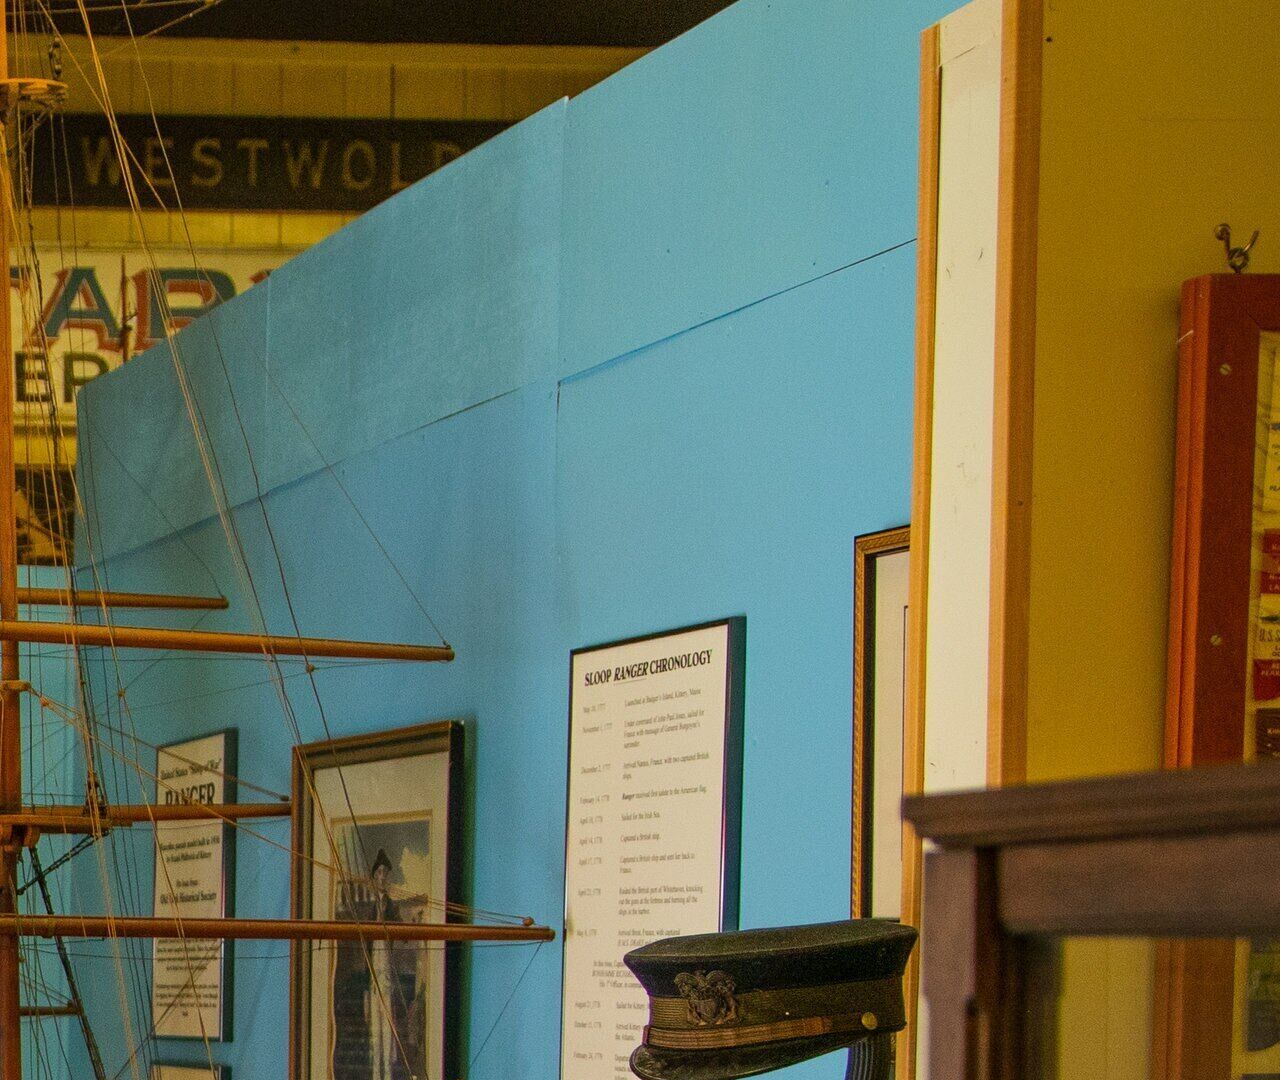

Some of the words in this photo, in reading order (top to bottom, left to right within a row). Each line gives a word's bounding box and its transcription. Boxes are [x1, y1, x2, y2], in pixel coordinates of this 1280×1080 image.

[584, 667, 611, 687] SLOOP
[613, 660, 648, 681] RANGER
[649, 648, 712, 675] CHRONOLOGY
